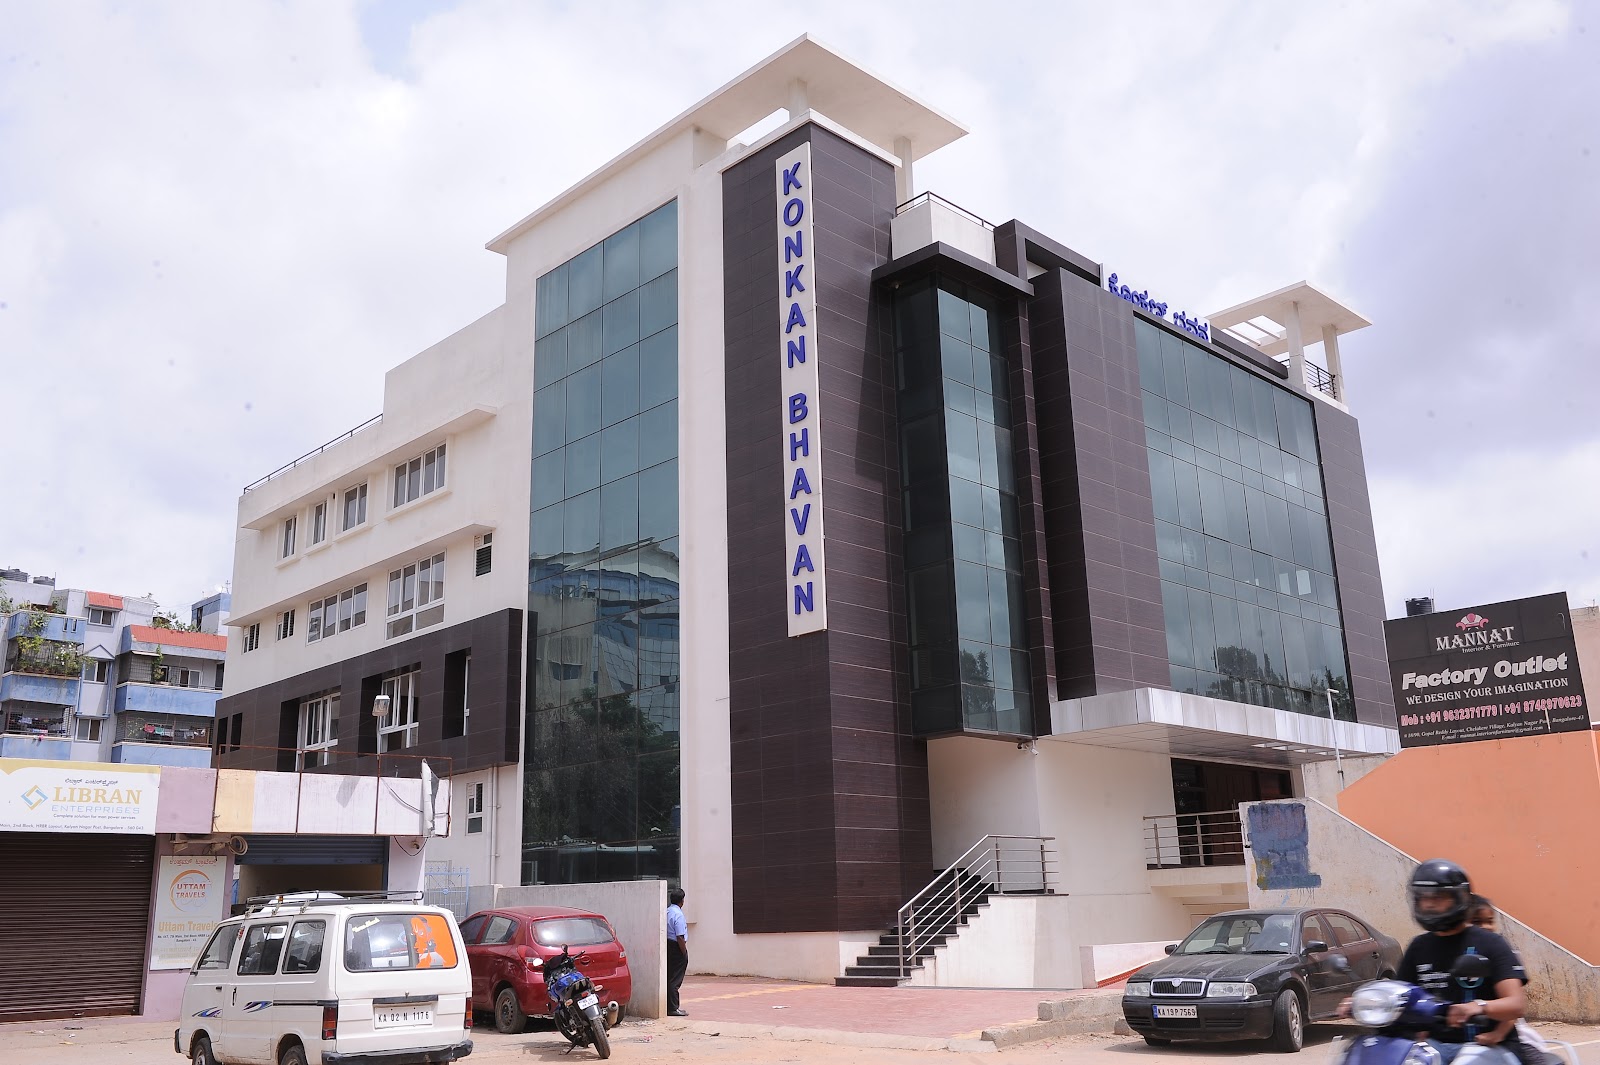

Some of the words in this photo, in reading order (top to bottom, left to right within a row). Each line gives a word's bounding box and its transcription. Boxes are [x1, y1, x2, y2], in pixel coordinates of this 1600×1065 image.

[782, 161, 807, 369] KONKAN
[788, 392, 815, 615] BHAVAN
[1435, 626, 1514, 651] MANNAT
[1492, 641, 1520, 649] Furniture
[1402, 666, 1489, 690] Factory
[1493, 652, 1568, 678] Outlet
[1406, 694, 1423, 705] WE
[1424, 690, 1462, 703] DESIGN
[1463, 686, 1493, 698] YOUR
[1494, 677, 1569, 695] IMAGINATION
[1425, 711, 1441, 723] +91
[1504, 701, 1521, 714] +91
[52, 786, 143, 805] LIBRAN
[51, 804, 140, 815] ENTERPRISES
[158, 921, 185, 932] Uttam
[187, 920, 218, 931] Travels
[378, 1013, 387, 1022] KA
[390, 1012, 400, 1022] 02
